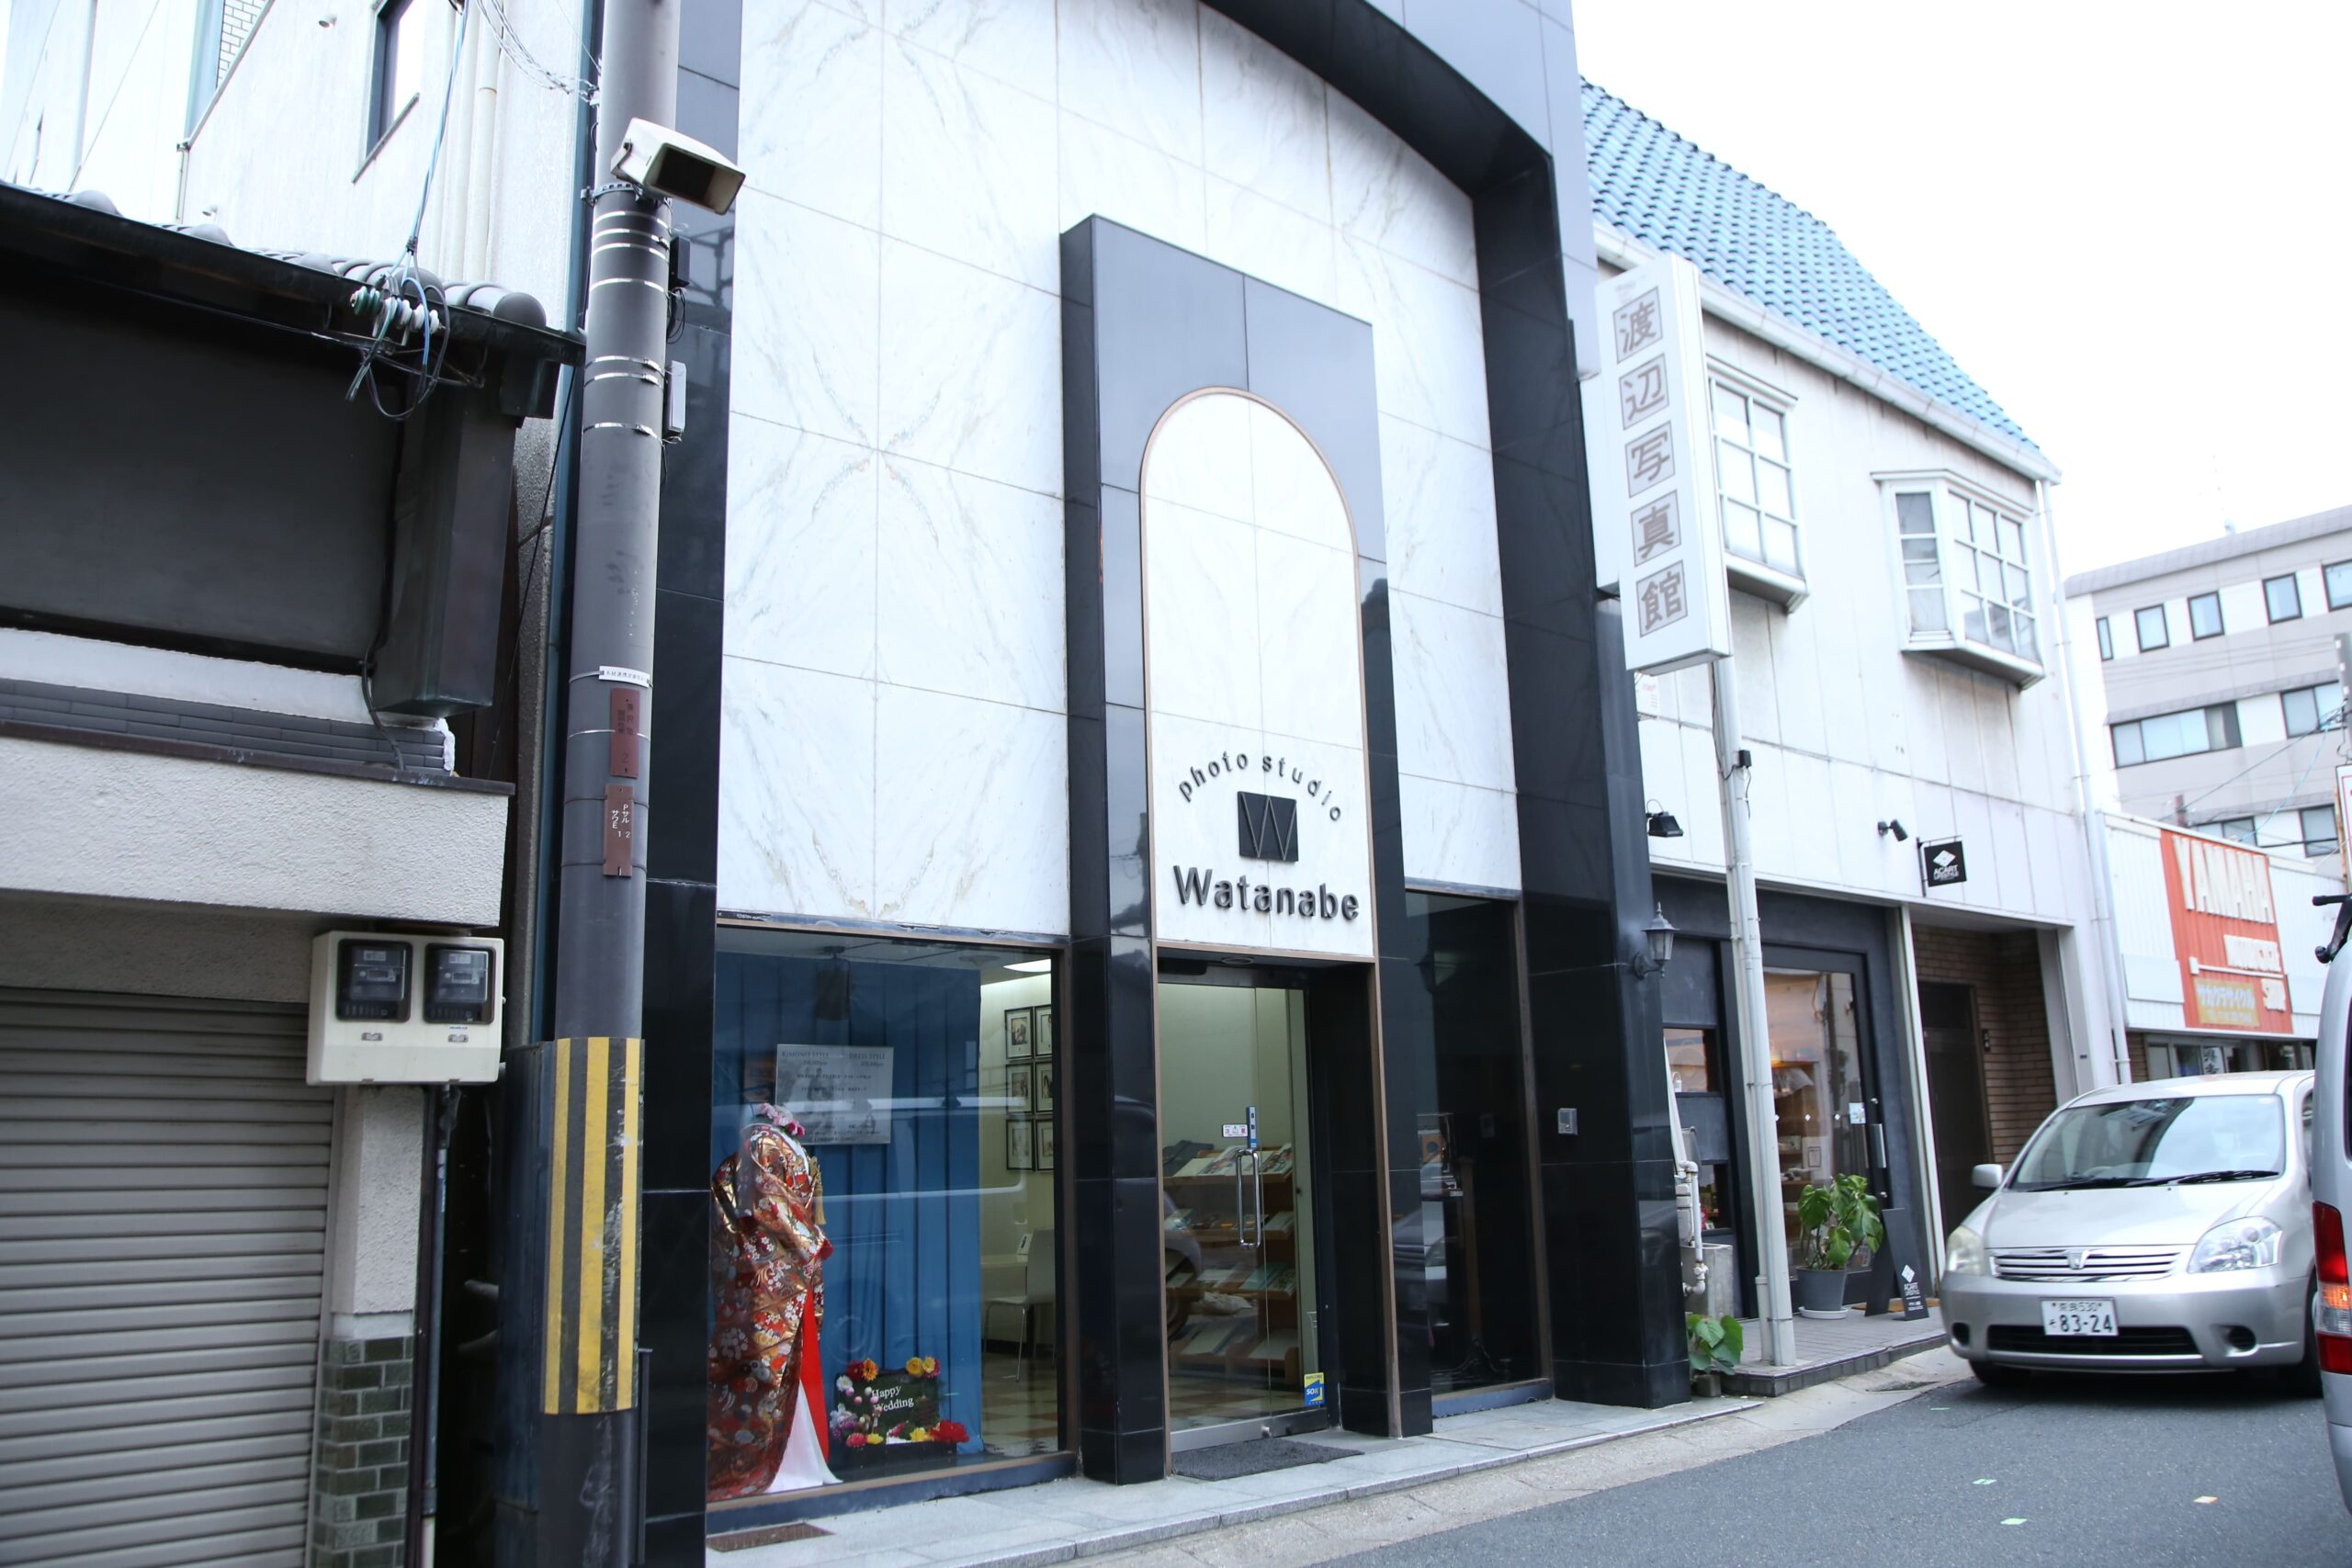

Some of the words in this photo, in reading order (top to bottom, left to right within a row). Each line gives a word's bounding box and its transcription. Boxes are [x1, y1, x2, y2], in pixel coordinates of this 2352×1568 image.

[1618, 301, 1685, 631] 渡辺写真館
[1179, 750, 1250, 803] photo
[1261, 754, 1341, 822] studio
[1172, 864, 1360, 920] Watanabe
[2060, 1314, 2112, 1333] 83-24
[871, 1385, 901, 1400] Happy
